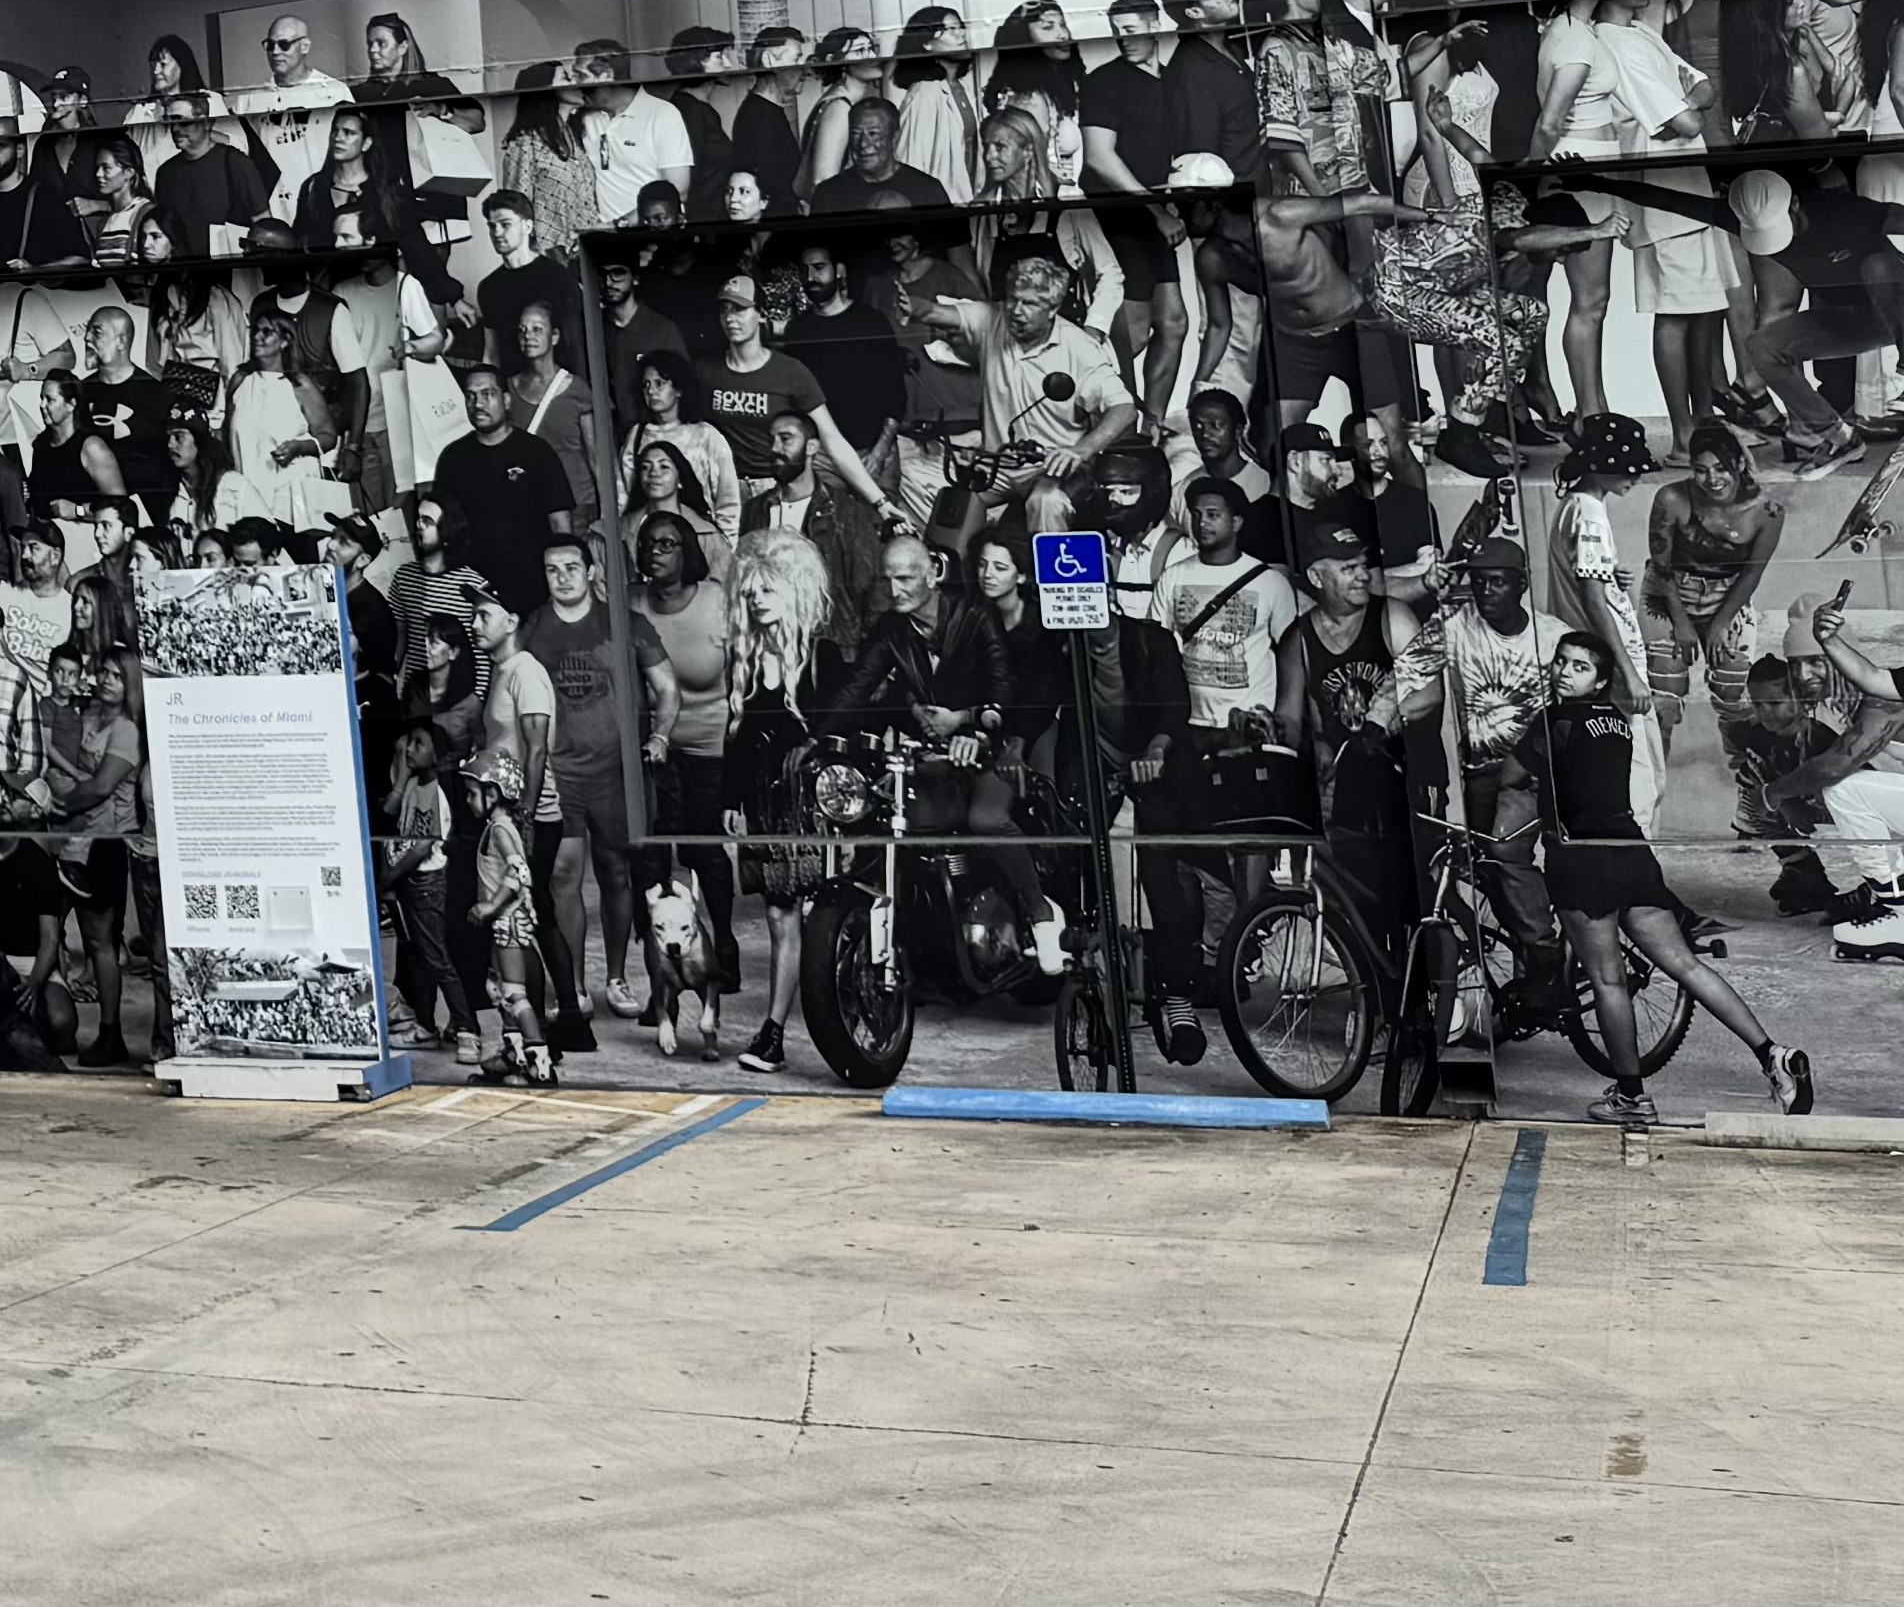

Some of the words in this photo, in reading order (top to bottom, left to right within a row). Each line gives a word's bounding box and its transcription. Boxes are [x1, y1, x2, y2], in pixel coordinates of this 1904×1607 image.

[712, 389, 768, 403] SOUTH
[712, 398, 768, 415] BEACH
[5, 605, 60, 639] Sober
[165, 692, 184, 706] JR
[168, 713, 189, 725] The
[192, 711, 257, 725] Chronicles
[260, 711, 273, 723] of
[276, 710, 313, 724] Miami
